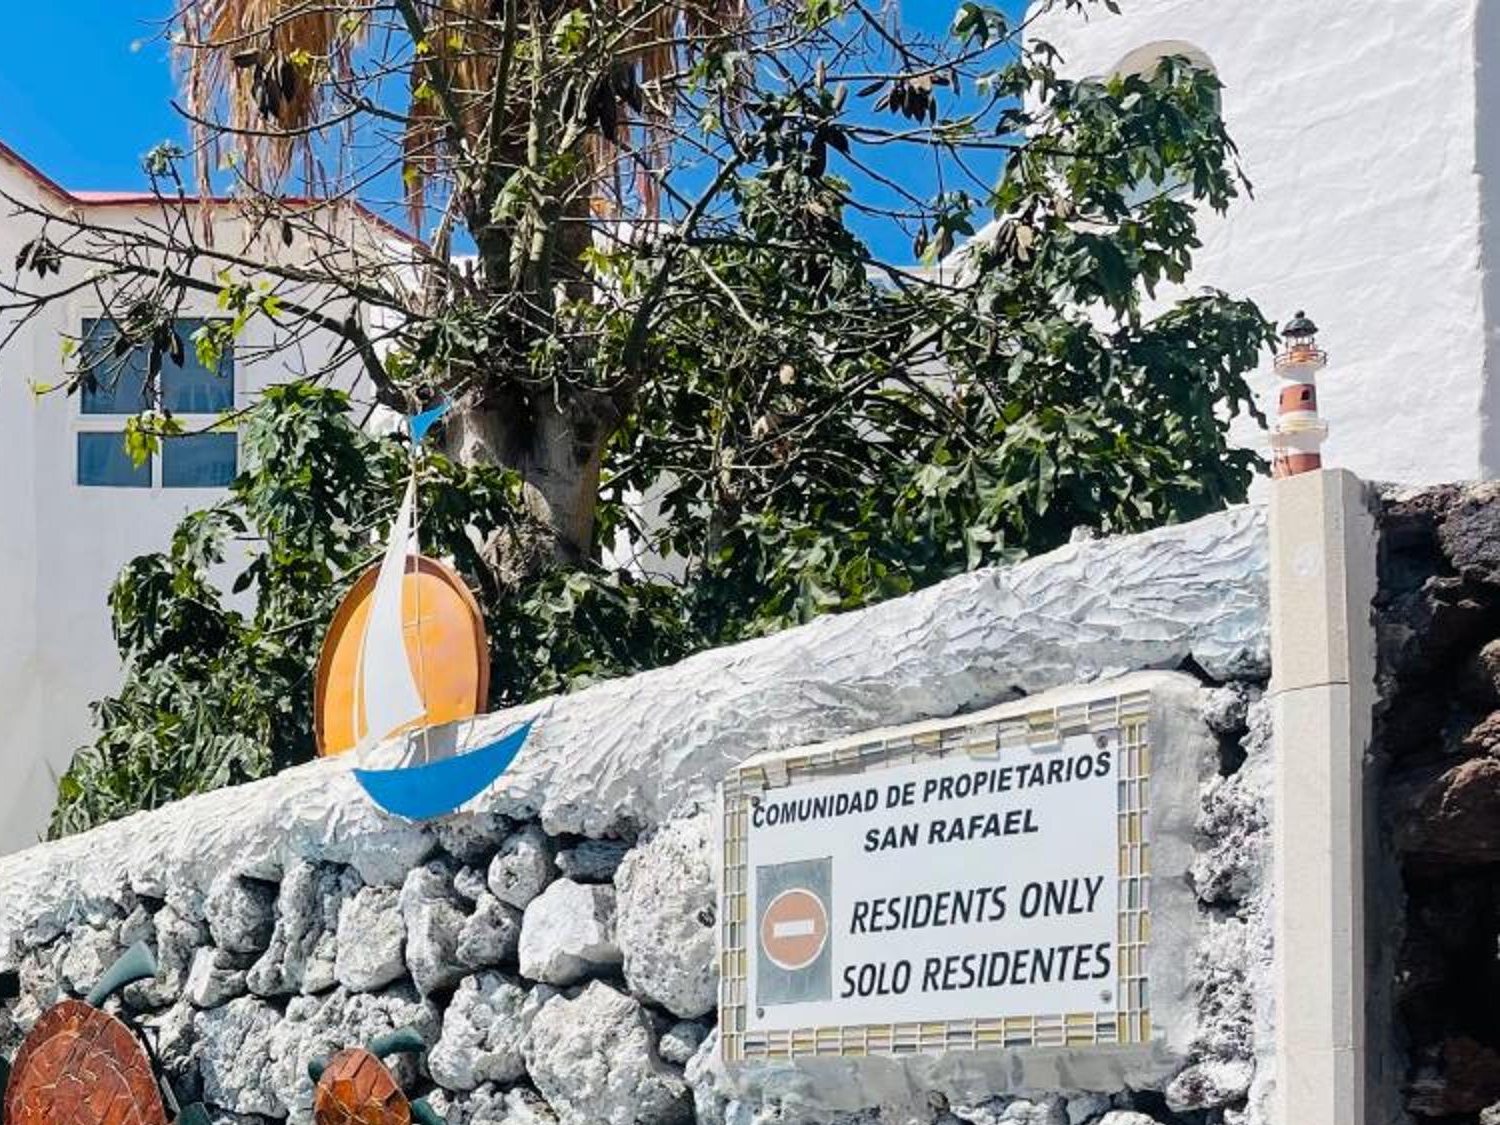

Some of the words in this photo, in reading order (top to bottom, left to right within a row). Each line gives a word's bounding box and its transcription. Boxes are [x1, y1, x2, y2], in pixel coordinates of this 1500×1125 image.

[751, 788, 879, 829] COMUNIDAD
[885, 781, 917, 809] DE
[922, 750, 1111, 803] PROPIETARIOS
[863, 823, 919, 853] SAN
[927, 808, 1039, 845] RAFAEL
[849, 885, 1007, 935] RESIDENTS
[1019, 875, 1104, 919] ONLY
[840, 959, 912, 999] SOLO
[921, 941, 1111, 993] RESIDENTES
